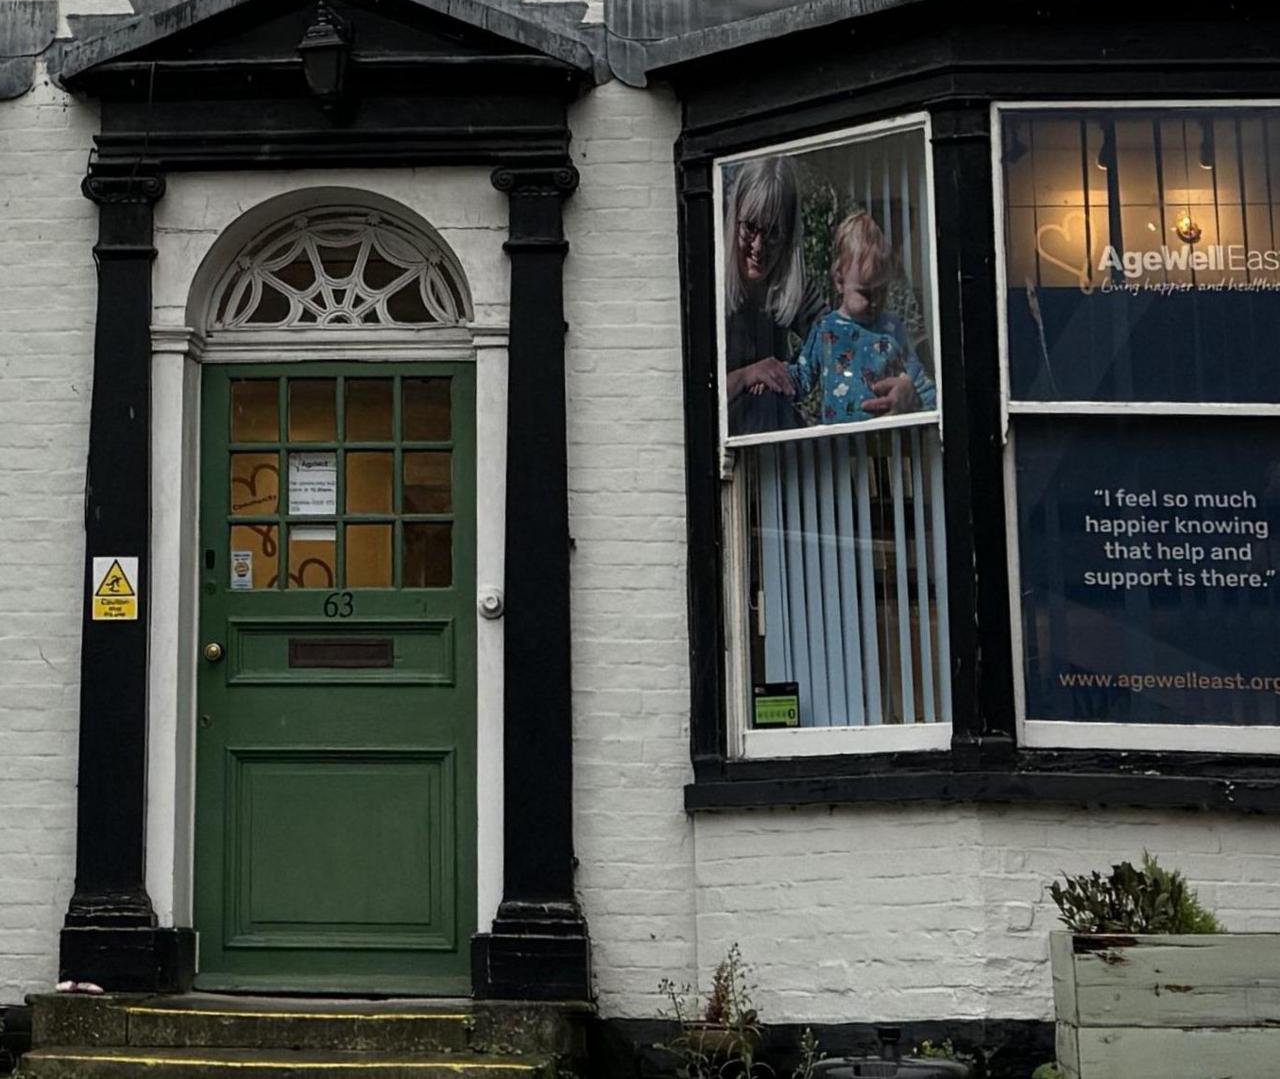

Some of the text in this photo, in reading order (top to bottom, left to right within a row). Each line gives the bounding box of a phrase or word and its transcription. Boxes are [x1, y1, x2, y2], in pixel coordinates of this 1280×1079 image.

[1101, 277, 1139, 296] Living
[1144, 277, 1195, 296] happier
[1198, 277, 1226, 292] and
[1115, 489, 1157, 508] feel
[1163, 493, 1188, 508] so
[1194, 491, 1257, 508] much
[1085, 515, 1269, 539] happier knowing
[1104, 541, 1252, 564] that help and
[1084, 568, 1172, 589] support
[1178, 569, 1196, 587] is
[323, 591, 354, 618] 63
